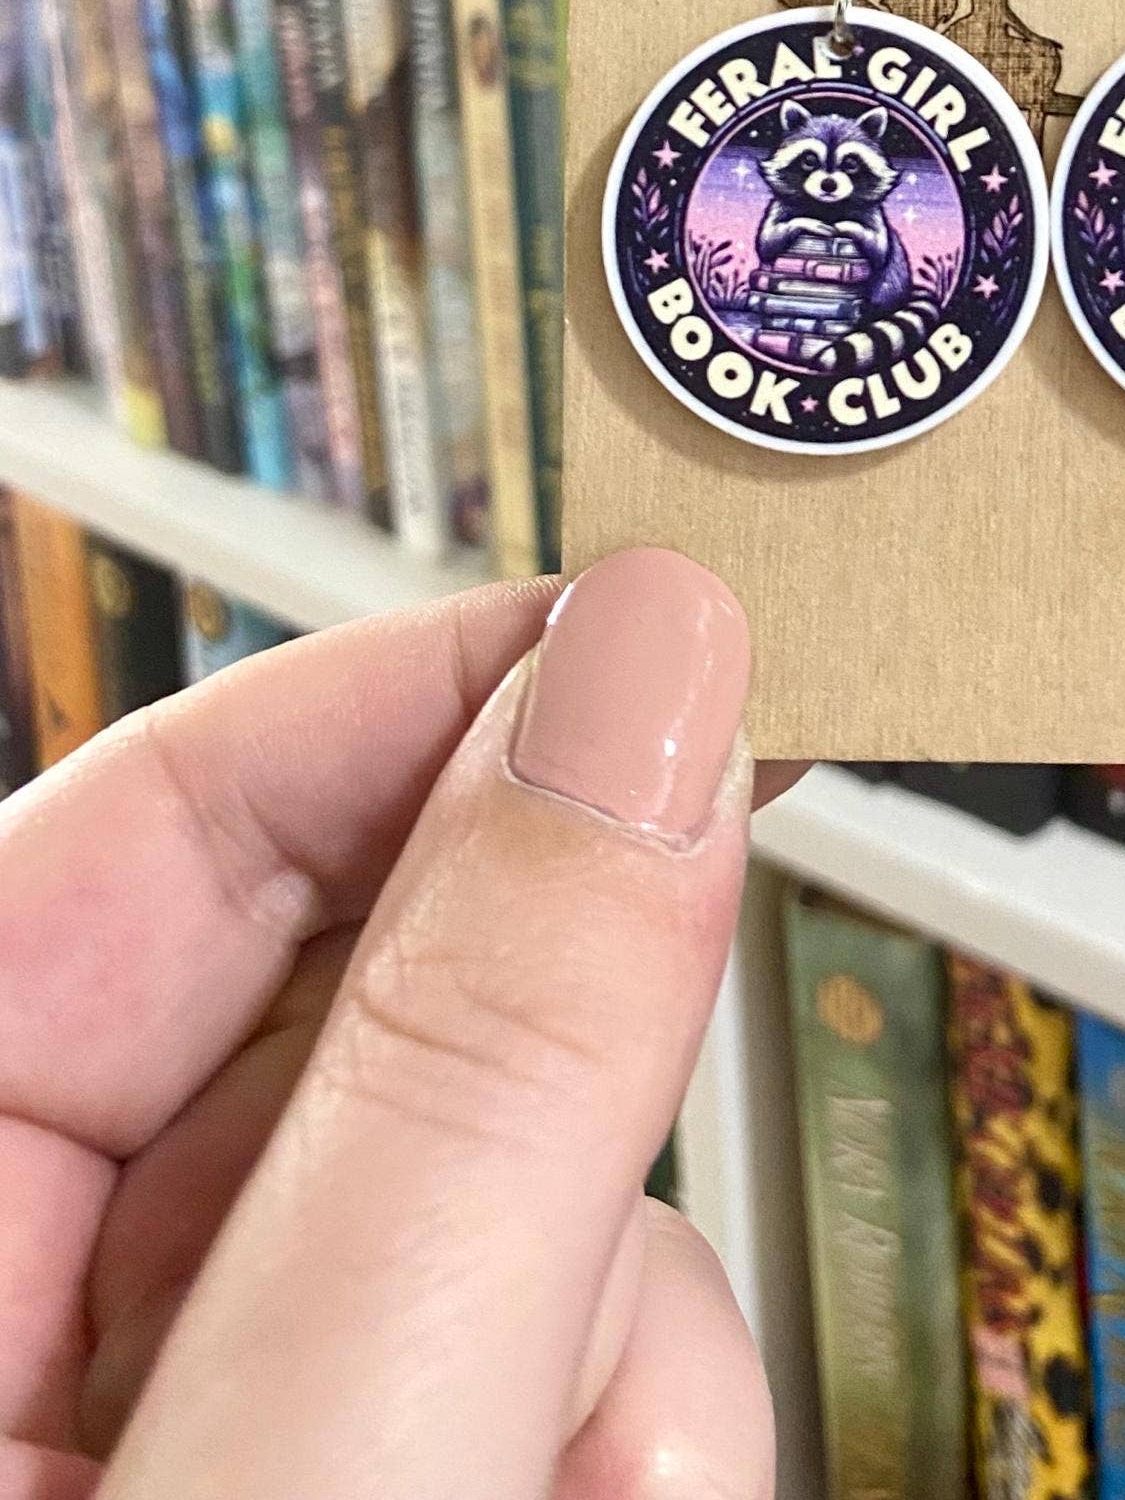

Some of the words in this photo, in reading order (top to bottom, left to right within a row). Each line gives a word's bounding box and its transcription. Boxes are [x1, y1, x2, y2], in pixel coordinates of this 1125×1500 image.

[665, 32, 848, 145] FERAL
[864, 46, 993, 174] GIRL
[647, 277, 798, 426] BOOK
[826, 321, 976, 428] CLUB
